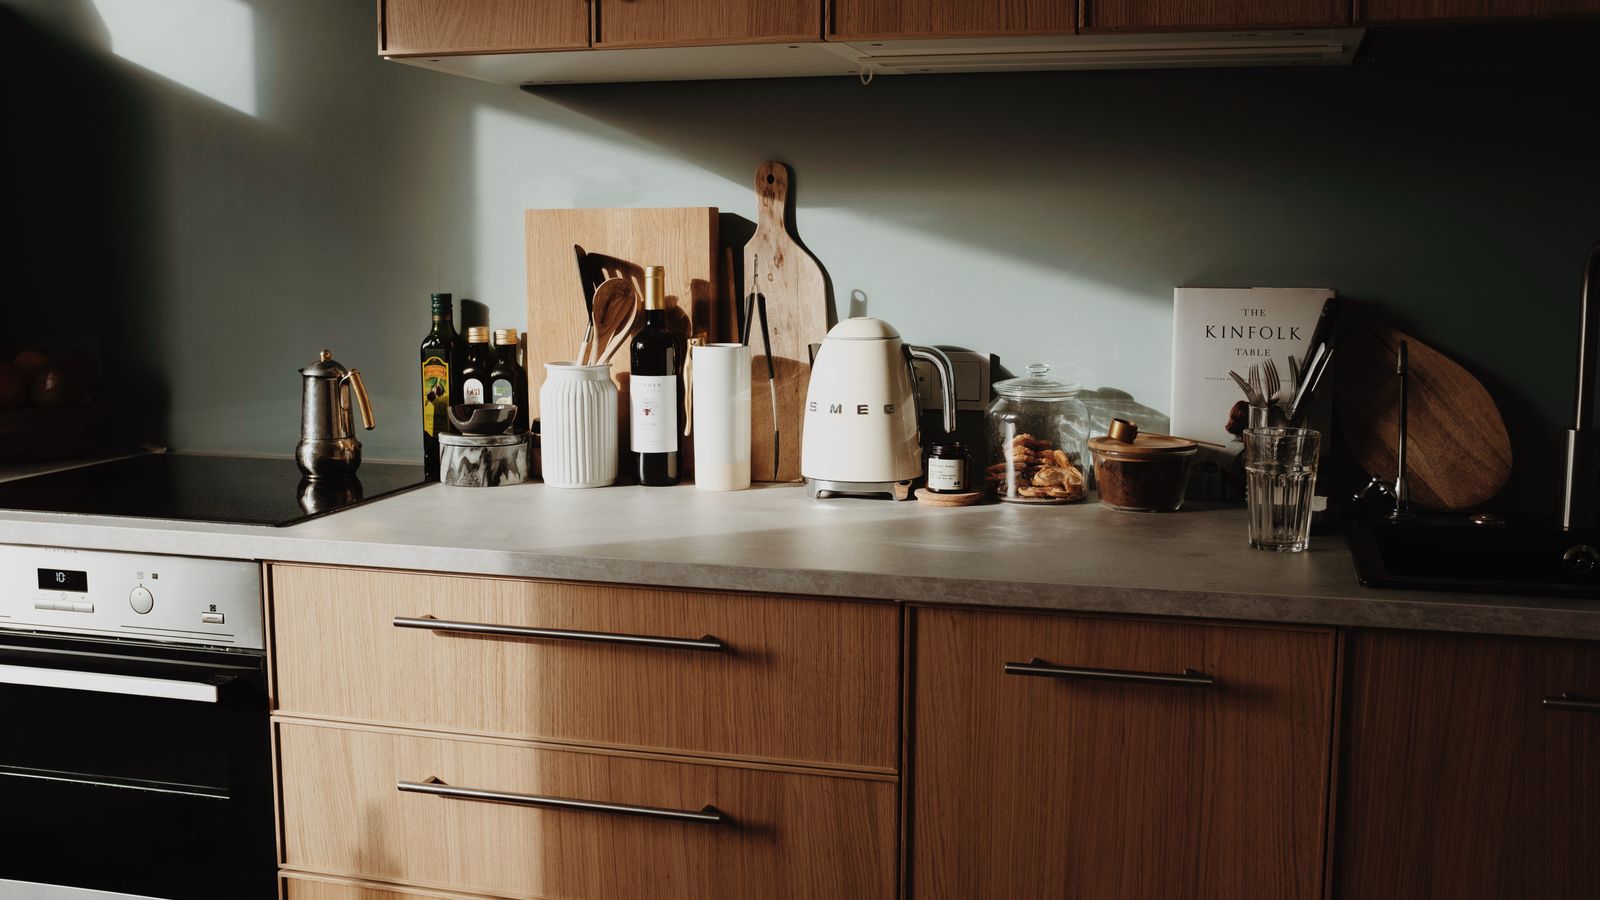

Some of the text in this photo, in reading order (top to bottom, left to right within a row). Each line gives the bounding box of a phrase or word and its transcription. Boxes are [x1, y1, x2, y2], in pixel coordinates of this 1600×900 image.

[1241, 308, 1267, 317] THE
[1205, 325, 1302, 341] KINFOLK
[1235, 347, 1271, 357] TABLE
[809, 401, 895, 415] SMEG
